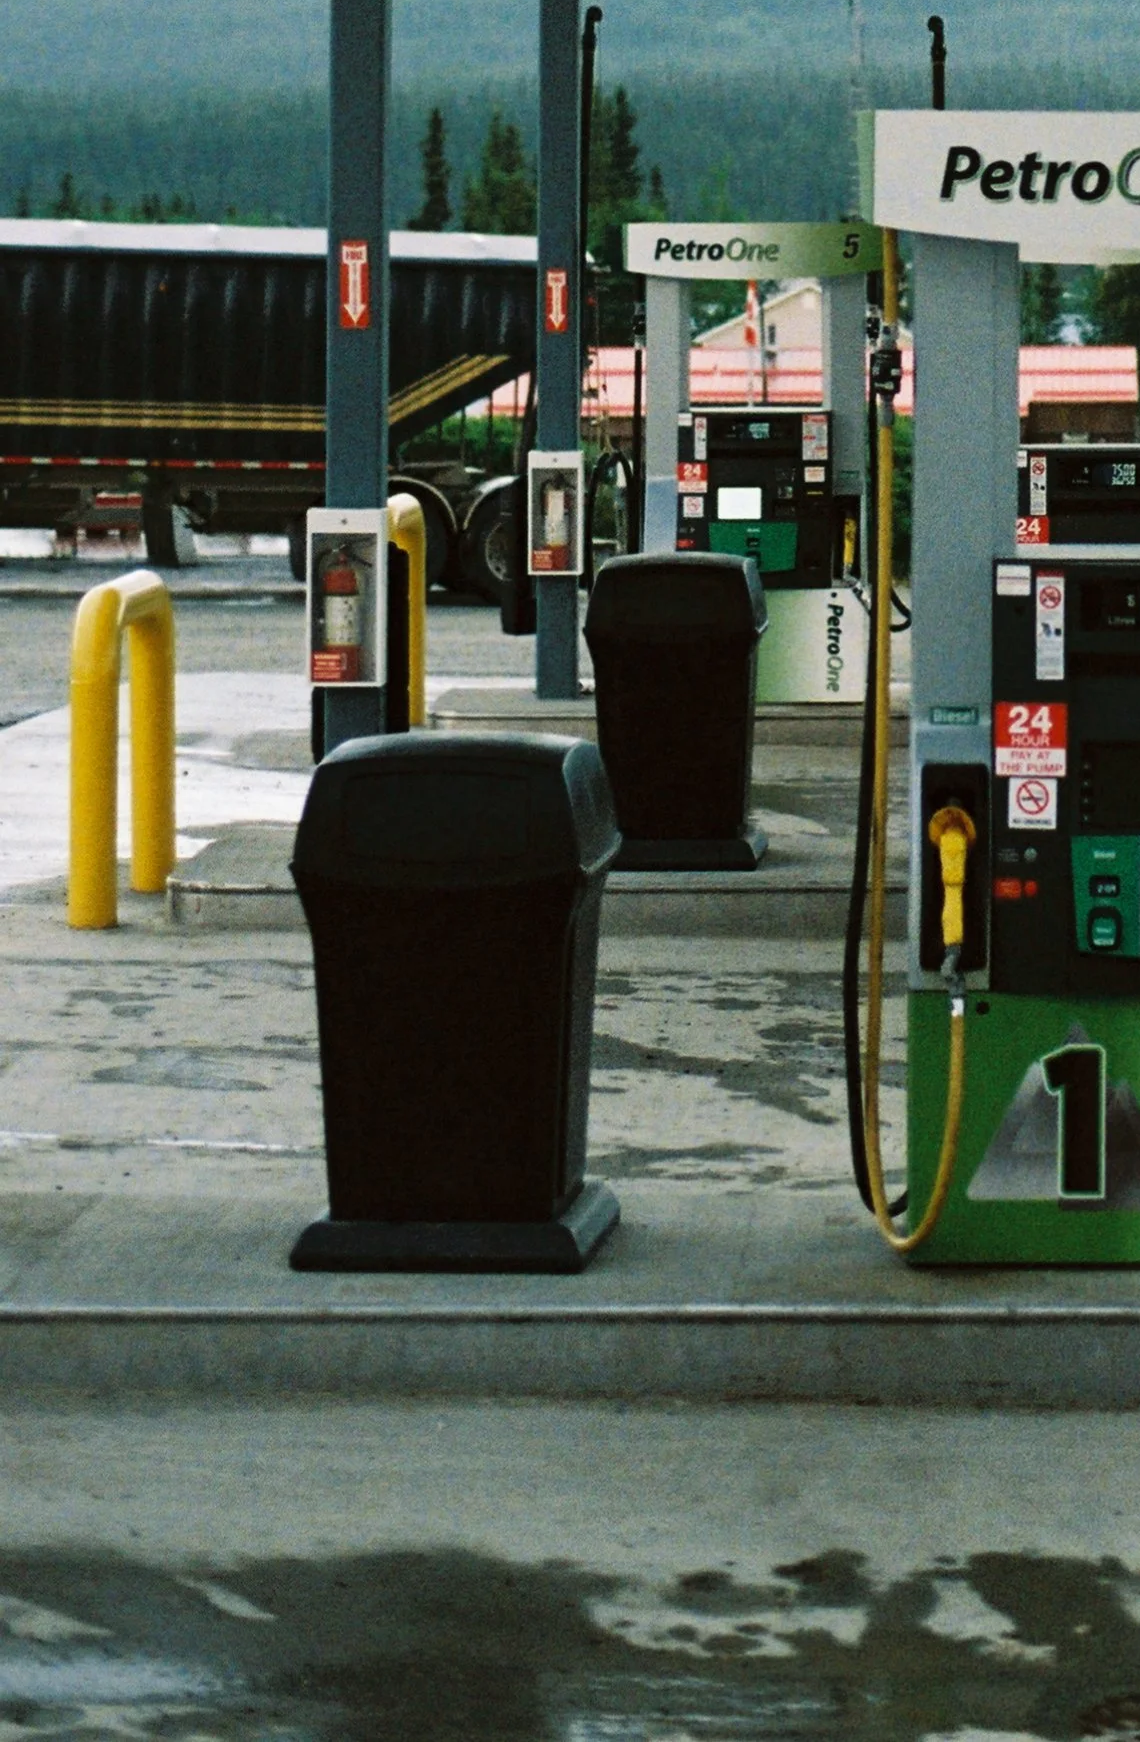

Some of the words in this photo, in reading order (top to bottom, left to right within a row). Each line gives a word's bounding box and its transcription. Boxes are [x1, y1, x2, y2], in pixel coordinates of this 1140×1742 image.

[654, 236, 781, 263] PetroOne
[842, 233, 861, 259] 5
[684, 464, 701, 478] 24
[1016, 518, 1042, 536] 24
[826, 603, 844, 693] PetroOne
[1008, 705, 1053, 735] 24
[1011, 734, 1050, 747] HOUR
[1010, 750, 1032, 759] PAY
[1036, 750, 1051, 759] AT
[1000, 763, 1021, 772] THE
[1026, 763, 1064, 773] PUMP
[1040, 1043, 1107, 1200] 1
